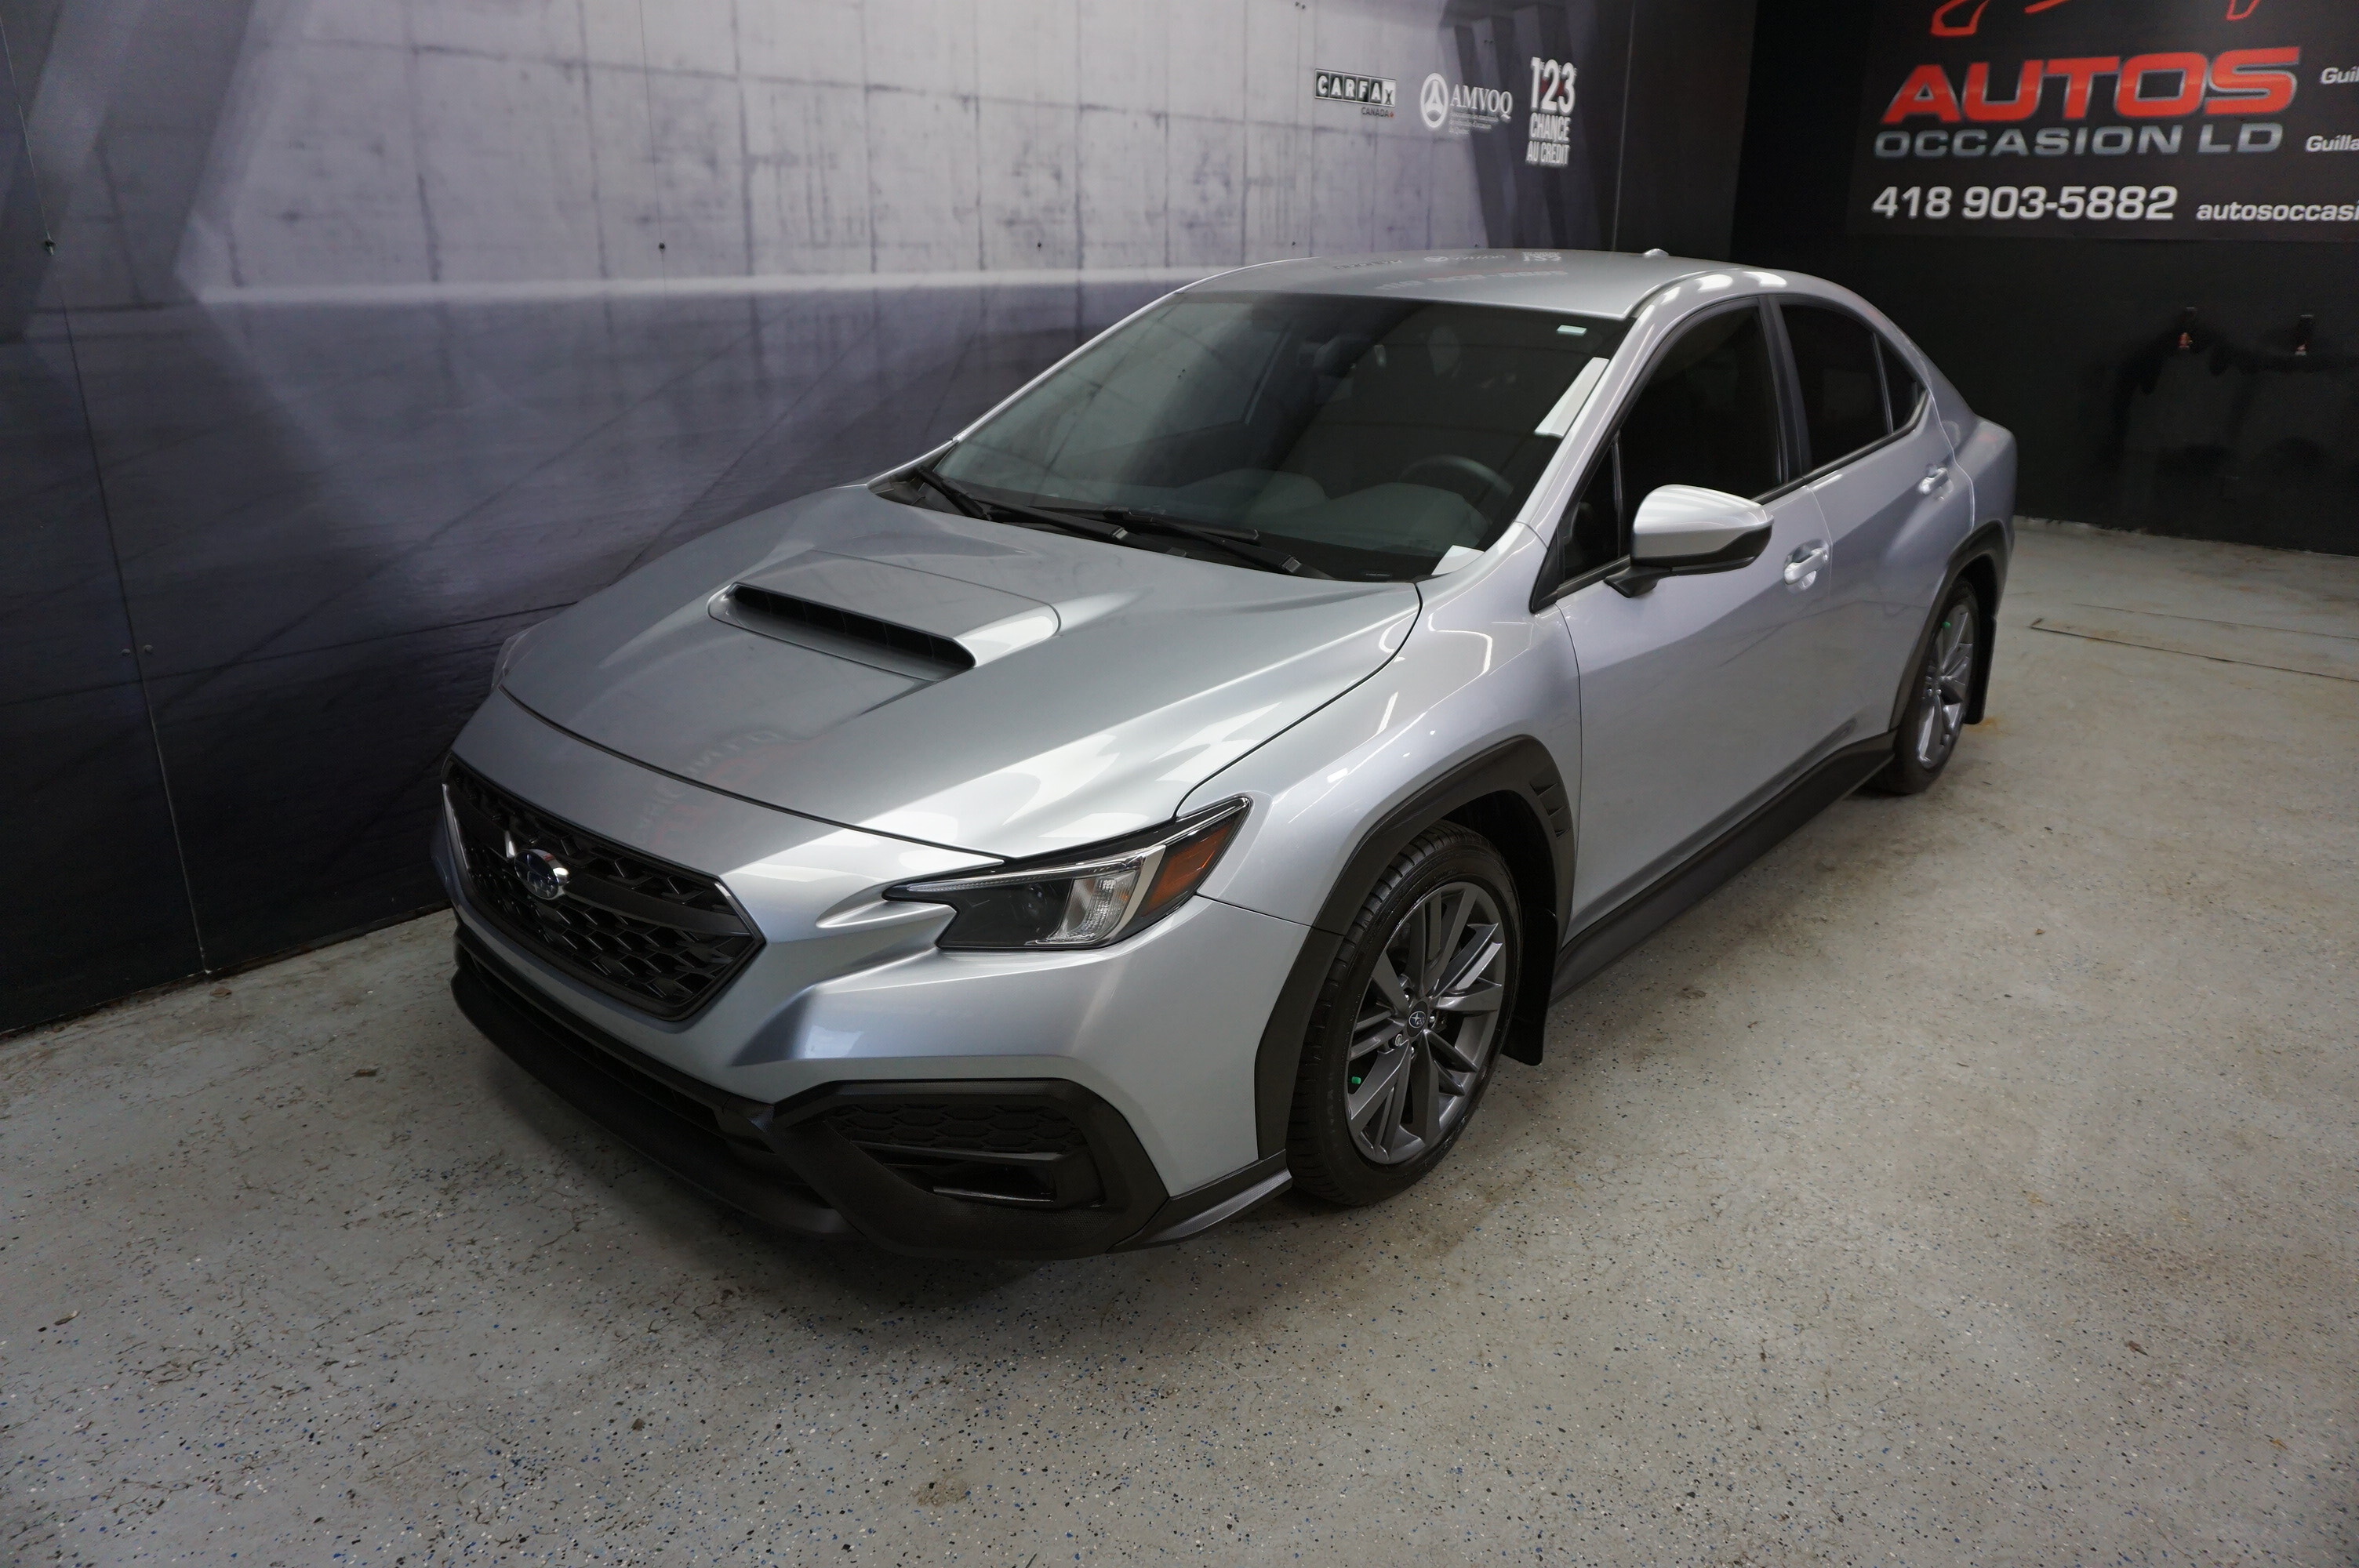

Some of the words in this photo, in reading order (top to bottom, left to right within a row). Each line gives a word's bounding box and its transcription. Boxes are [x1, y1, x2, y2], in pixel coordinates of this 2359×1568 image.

[1318, 74, 1393, 105] CARFAX
[1449, 83, 1513, 119] AMVOQ
[1882, 47, 2299, 124] AUTOS
[1361, 107, 1389, 118] CANADA
[1529, 112, 1570, 141] CHANCE
[1525, 140, 1539, 162] AU
[1875, 124, 2183, 158] OCCASION
[2197, 123, 2283, 153] LD
[1872, 186, 1952, 219] 418
[1962, 185, 2178, 220] 903-5882
